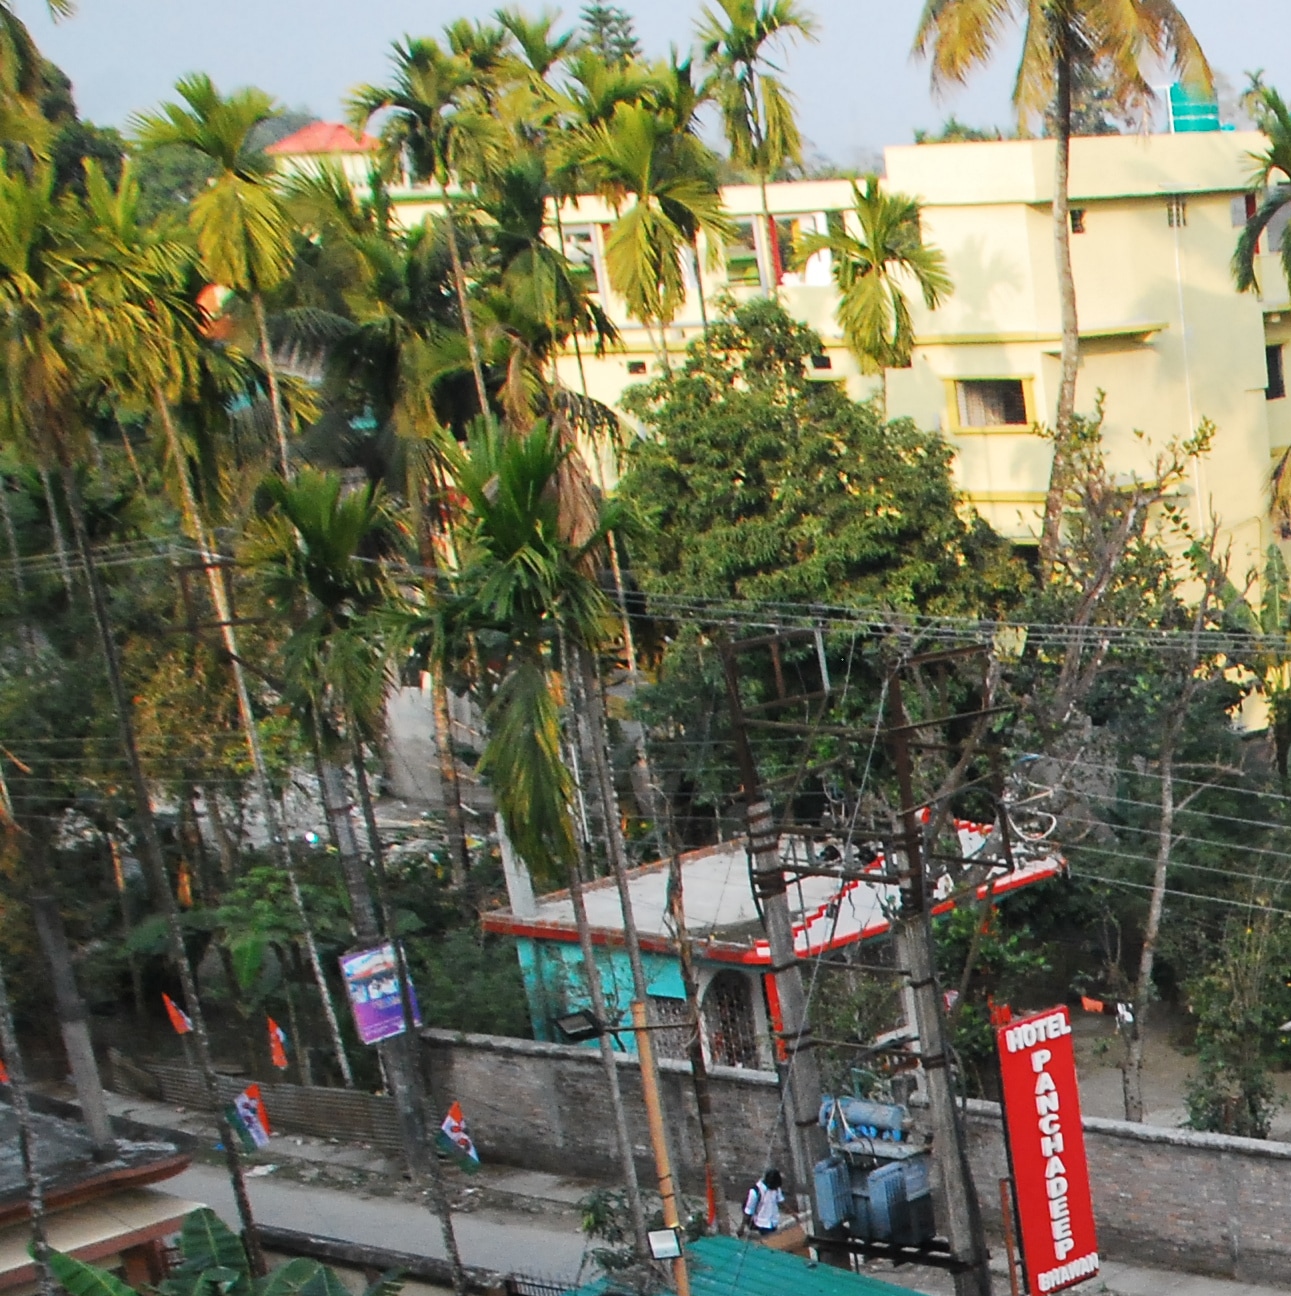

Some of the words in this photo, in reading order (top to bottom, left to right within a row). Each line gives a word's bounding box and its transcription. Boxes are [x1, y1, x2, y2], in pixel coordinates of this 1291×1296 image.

[1006, 1012, 1071, 1052] HOTEL
[1031, 1049, 1074, 1260] PANCHADEEP
[1038, 1252, 1099, 1292] BHAWAN
